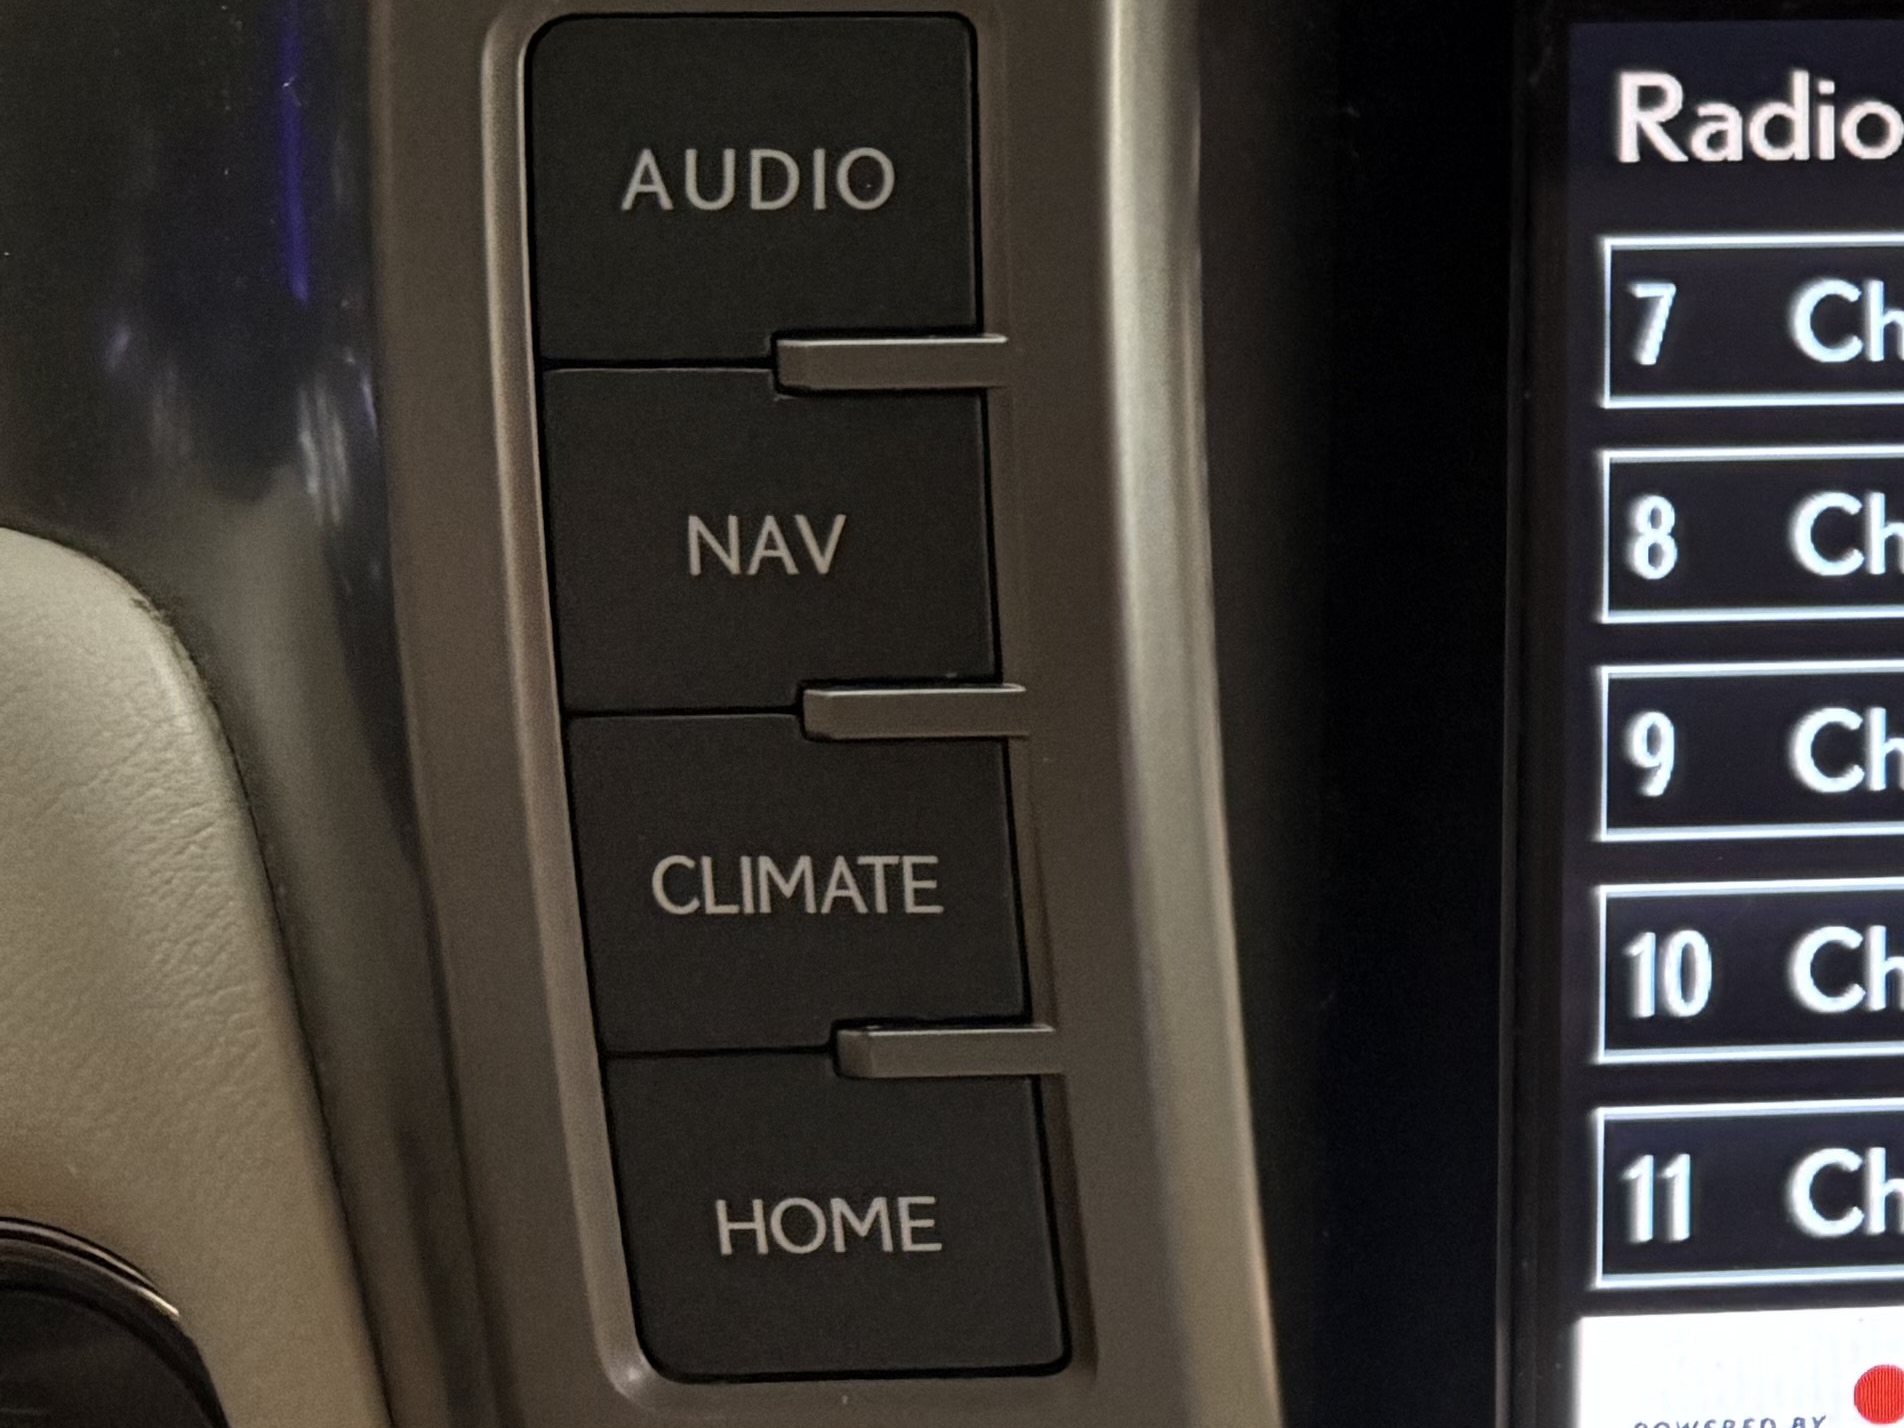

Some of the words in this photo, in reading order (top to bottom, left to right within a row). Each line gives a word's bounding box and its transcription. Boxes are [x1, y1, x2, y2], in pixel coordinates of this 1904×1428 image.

[620, 146, 896, 212] AUDIO
[1630, 280, 1678, 367] 7
[686, 513, 847, 577] NAV
[1627, 493, 1680, 582] 8
[1626, 709, 1677, 798] 9
[650, 853, 944, 916] CLIMATE
[1625, 927, 1714, 1019] 10
[714, 1194, 943, 1256] HOME
[1623, 1152, 1692, 1244] 11
